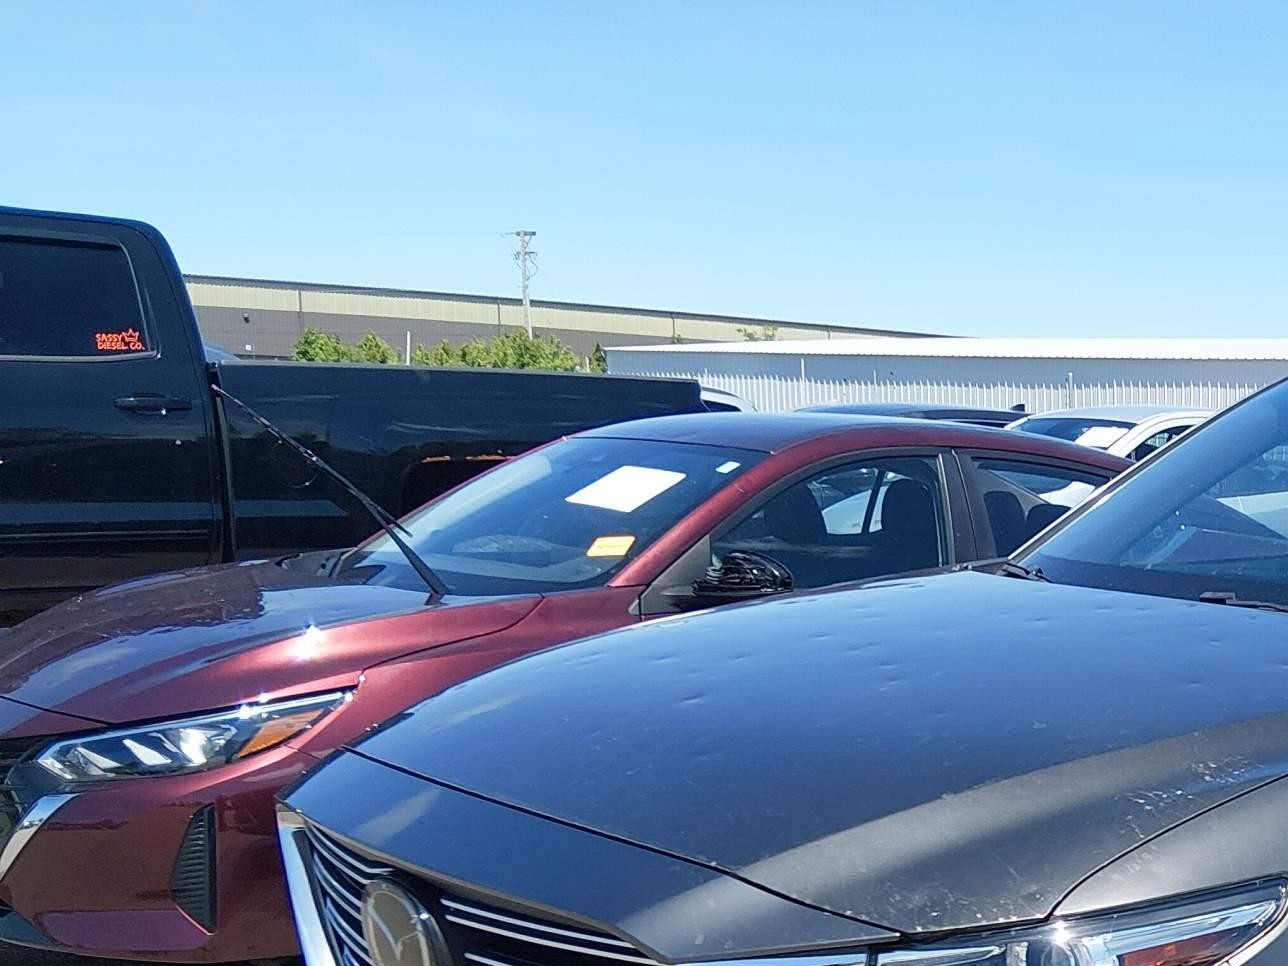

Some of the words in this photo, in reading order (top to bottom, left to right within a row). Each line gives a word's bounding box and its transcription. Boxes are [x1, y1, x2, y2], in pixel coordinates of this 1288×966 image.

[95, 333, 122, 342] SASSY
[97, 341, 129, 350] DIESEL
[130, 342, 145, 350] CO.
